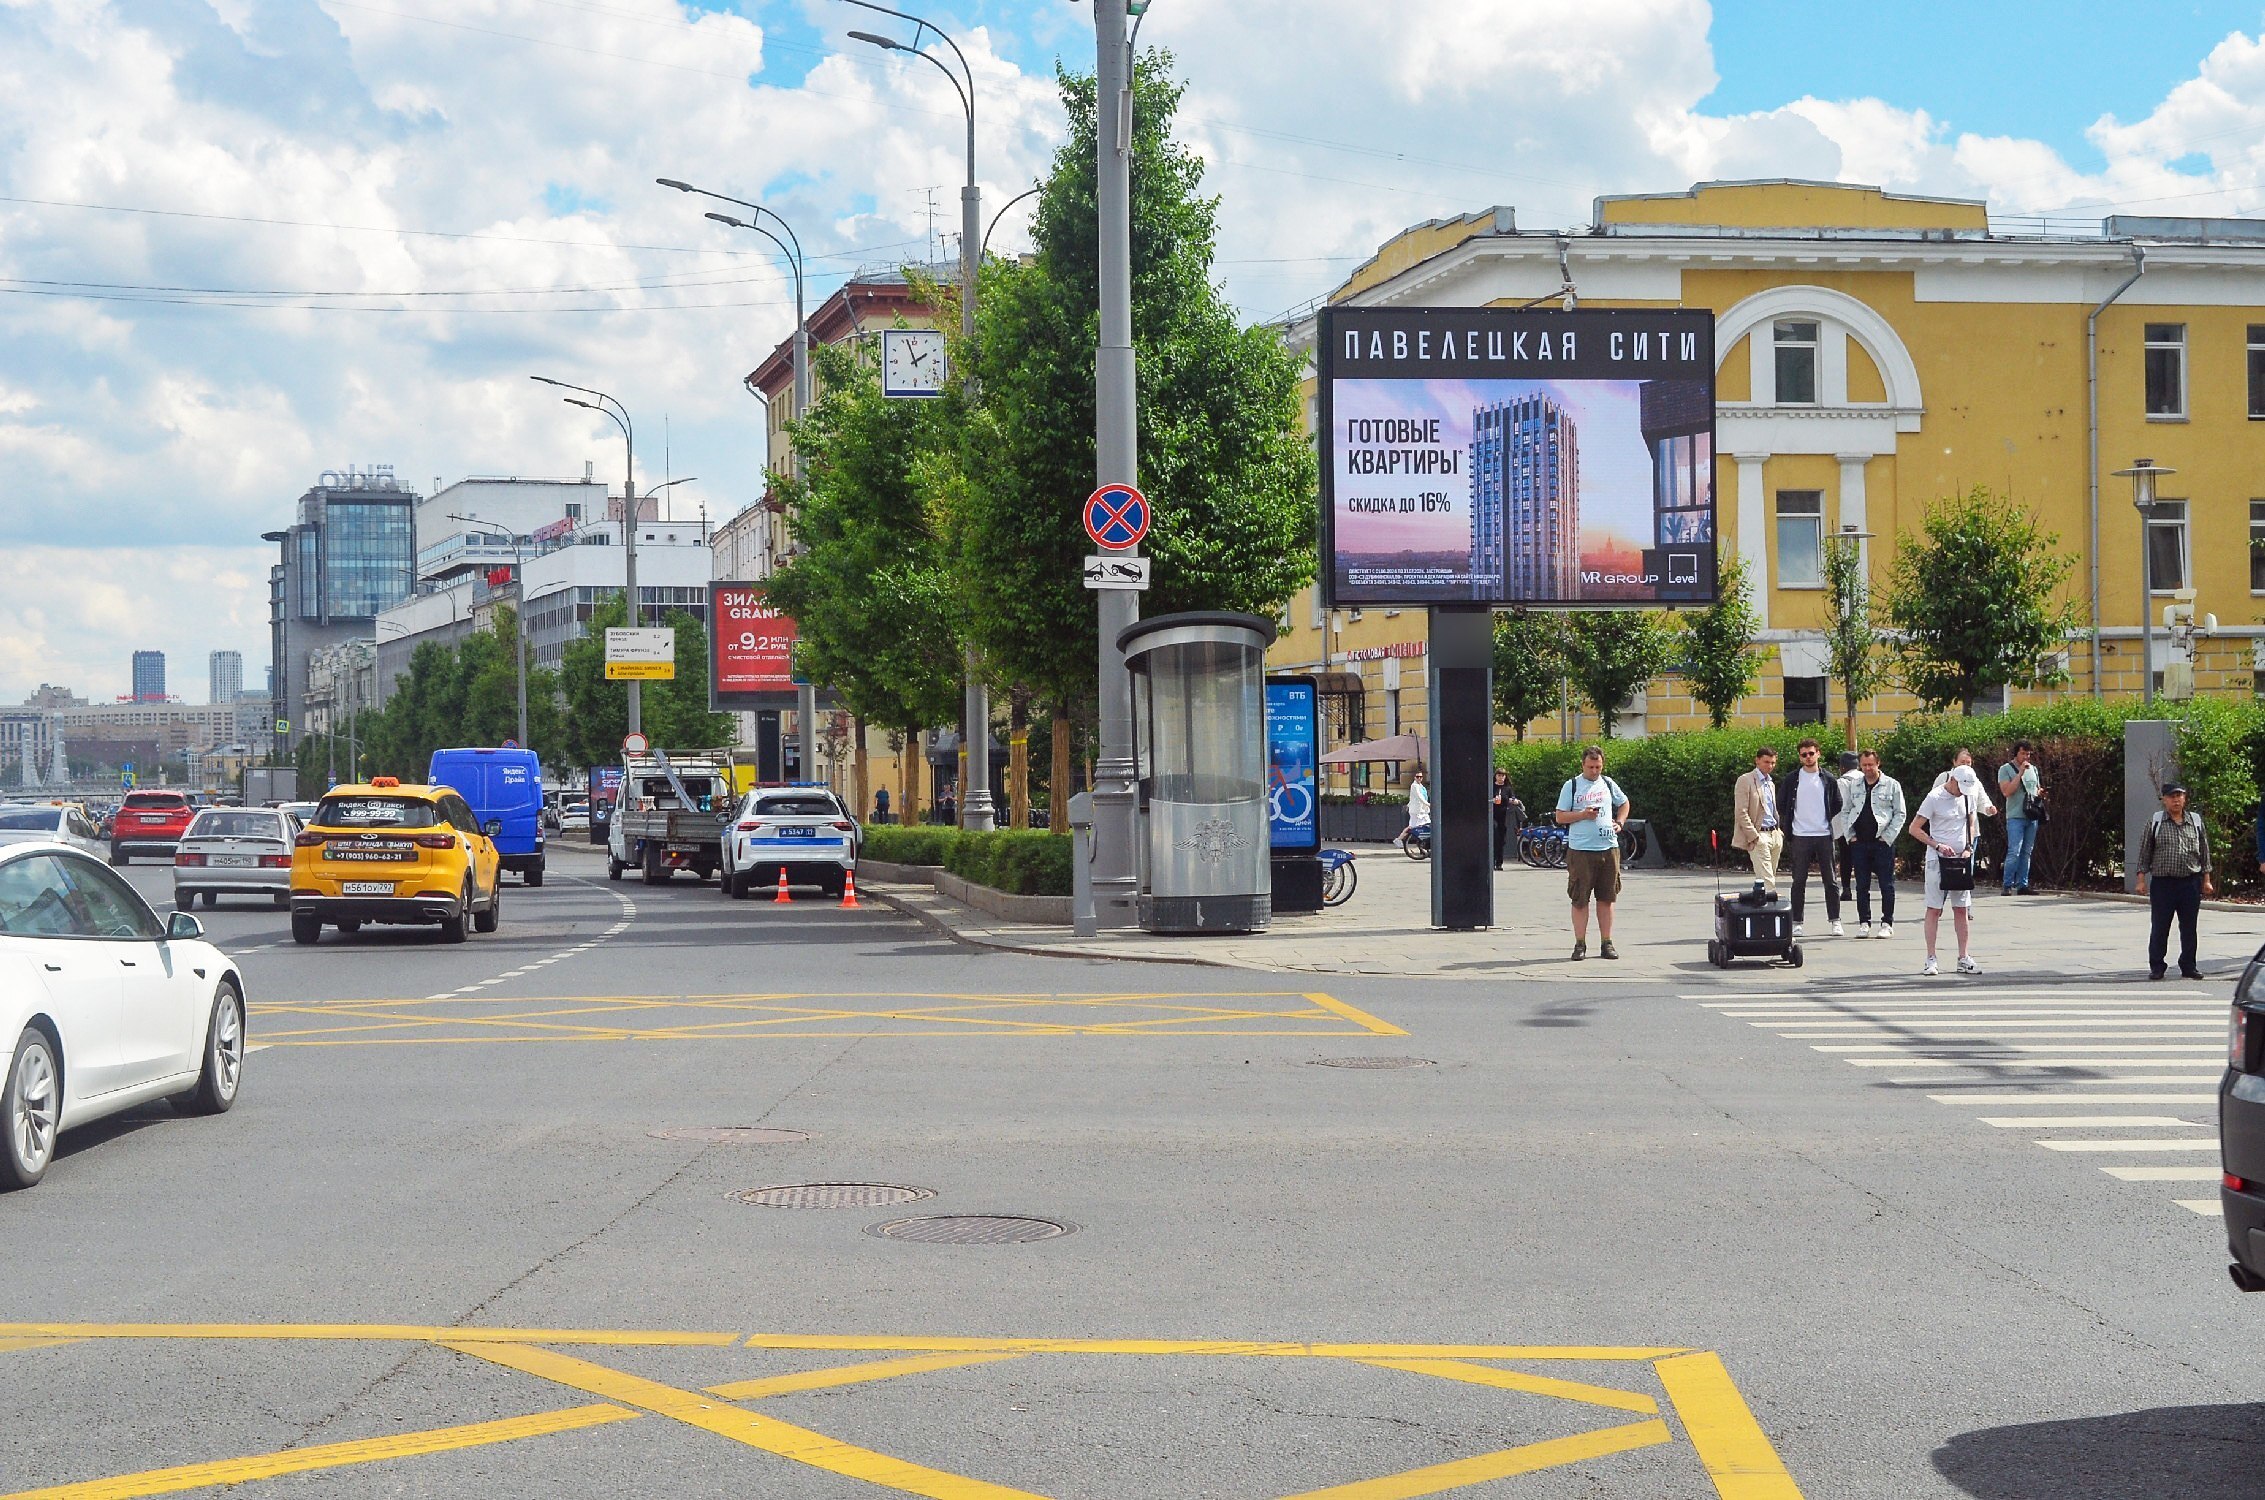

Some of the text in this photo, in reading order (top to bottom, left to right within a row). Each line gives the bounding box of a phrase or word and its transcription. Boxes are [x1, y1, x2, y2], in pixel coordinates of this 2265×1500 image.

[1344, 330, 1697, 361] ПАВЕЛЕЦКАЯ СИТИ
[1348, 419, 1441, 444] ГОТОВЫЕ
[1348, 492, 1451, 514] СКИДКА ДО 16%
[1580, 571, 1659, 584] MR GROUP
[1668, 573, 1698, 584] Level
[740, 632, 769, 652] 9,2
[1289, 691, 1306, 700] ВТБ
